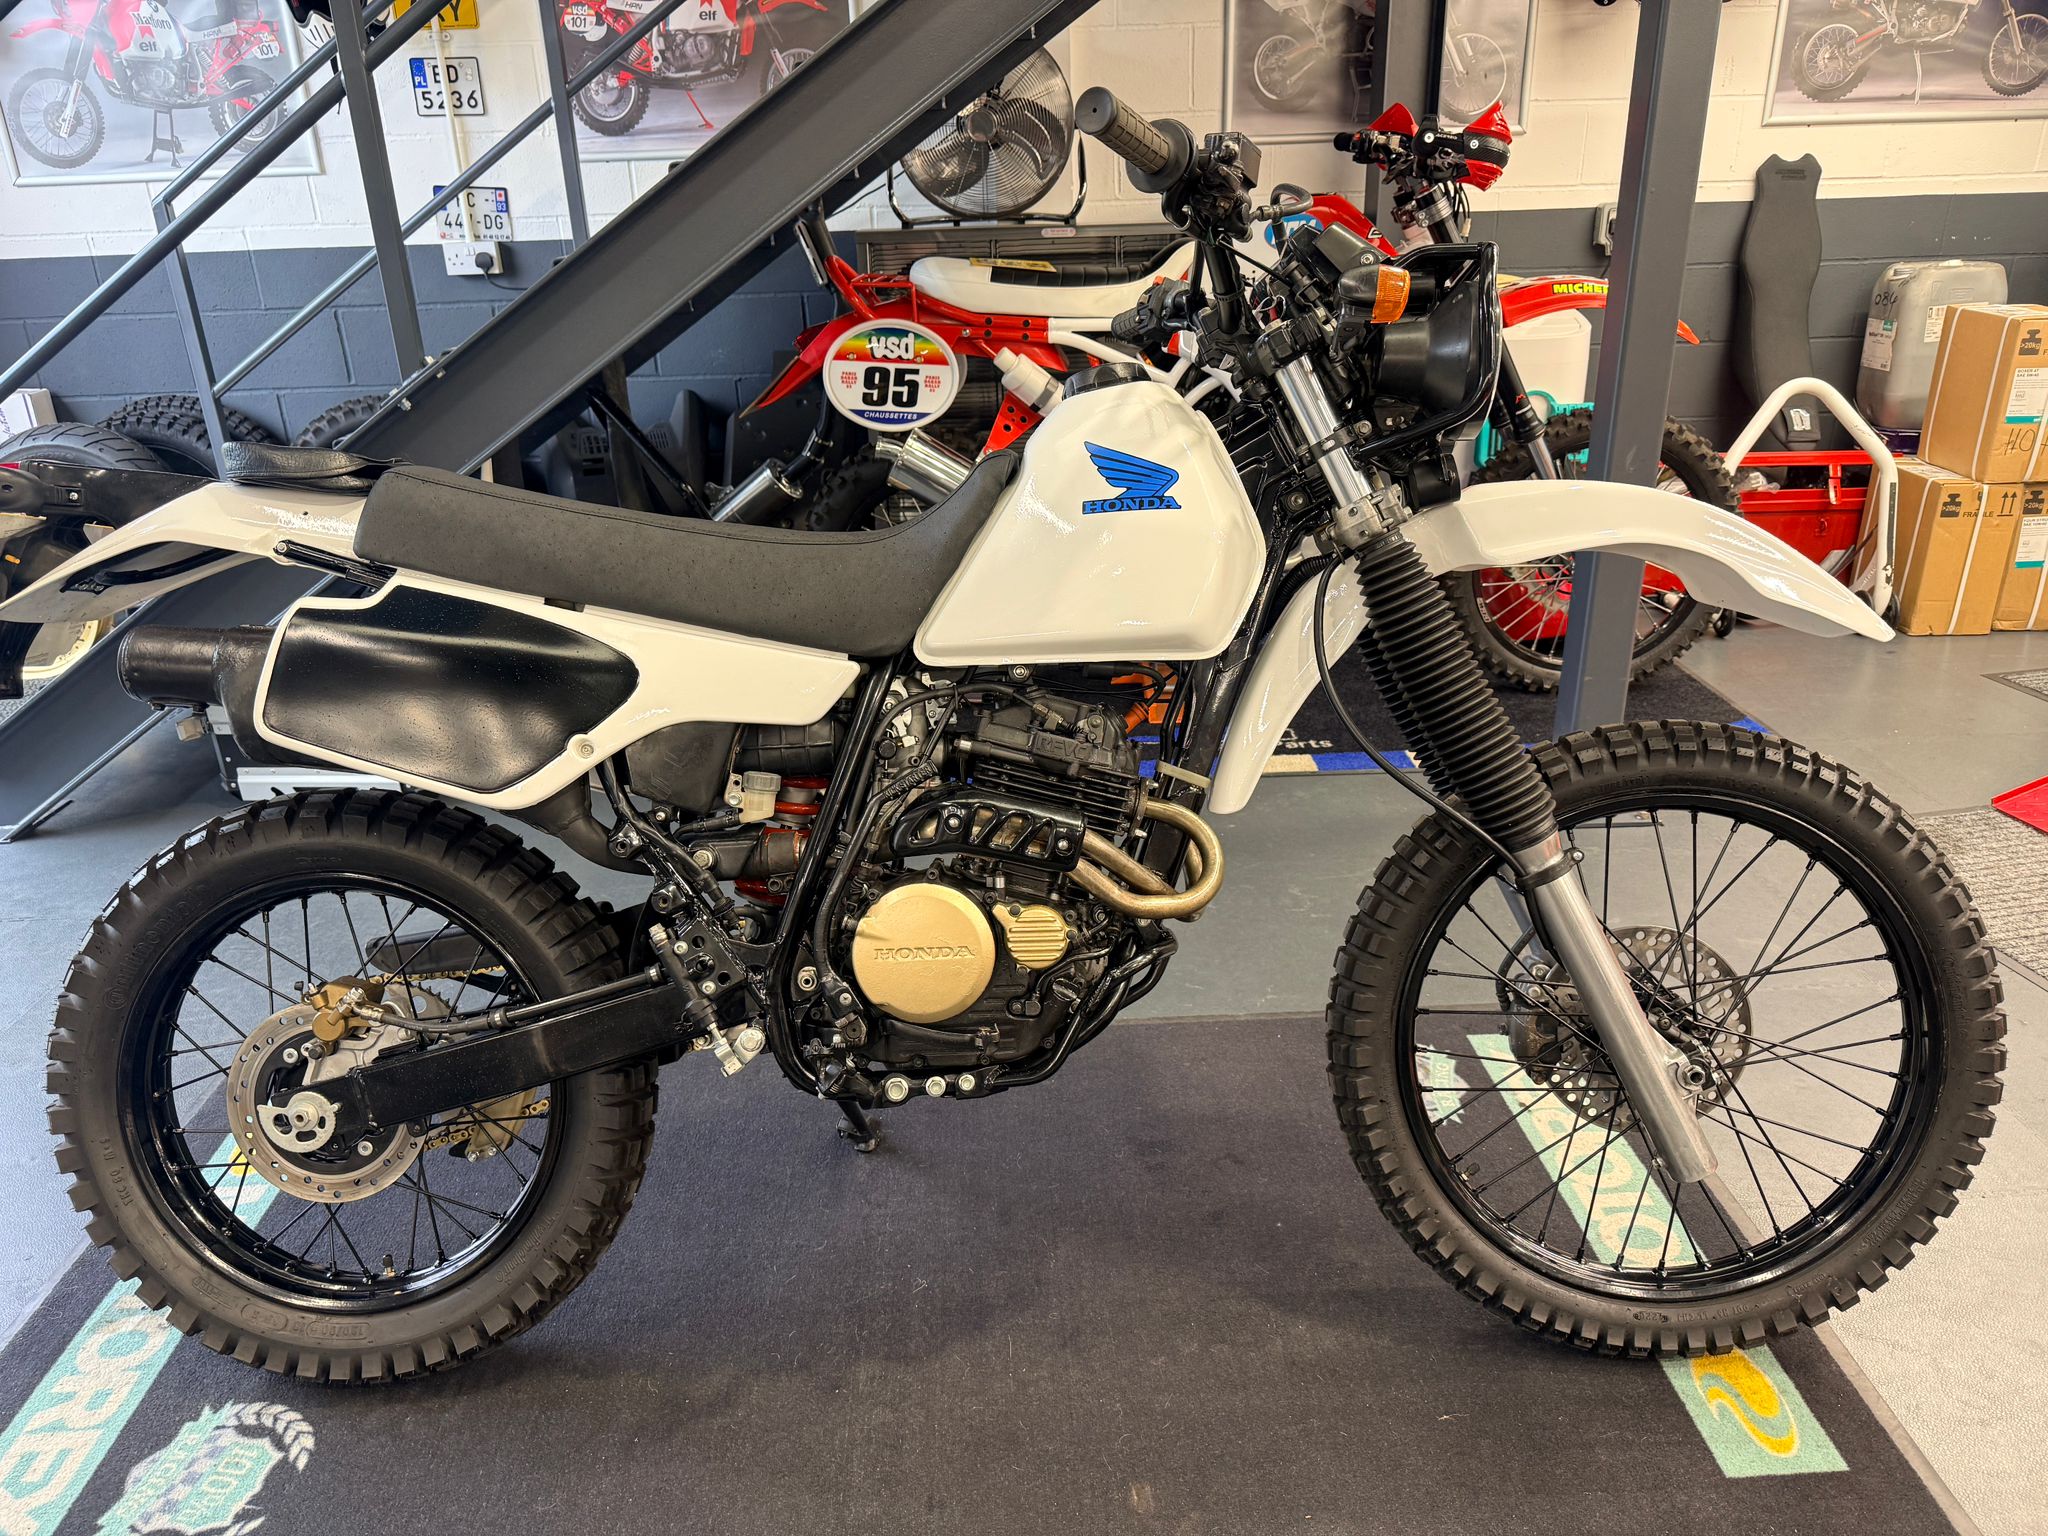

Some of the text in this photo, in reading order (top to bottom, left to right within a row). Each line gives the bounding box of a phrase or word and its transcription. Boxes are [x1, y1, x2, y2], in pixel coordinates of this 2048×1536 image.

[132, 12, 172, 31] Marlboro
[699, 11, 718, 21] elf
[570, 16, 587, 29] 101
[138, 41, 158, 52] elf
[257, 45, 274, 57] 101
[414, 76, 427, 87] PL
[496, 202, 507, 211] 93
[862, 366, 920, 408] 95
[864, 411, 918, 420] CHAUSSETTES
[1083, 497, 1180, 514] HONDA
[1277, 739, 1334, 749] arts
[873, 945, 976, 961] HONDA
